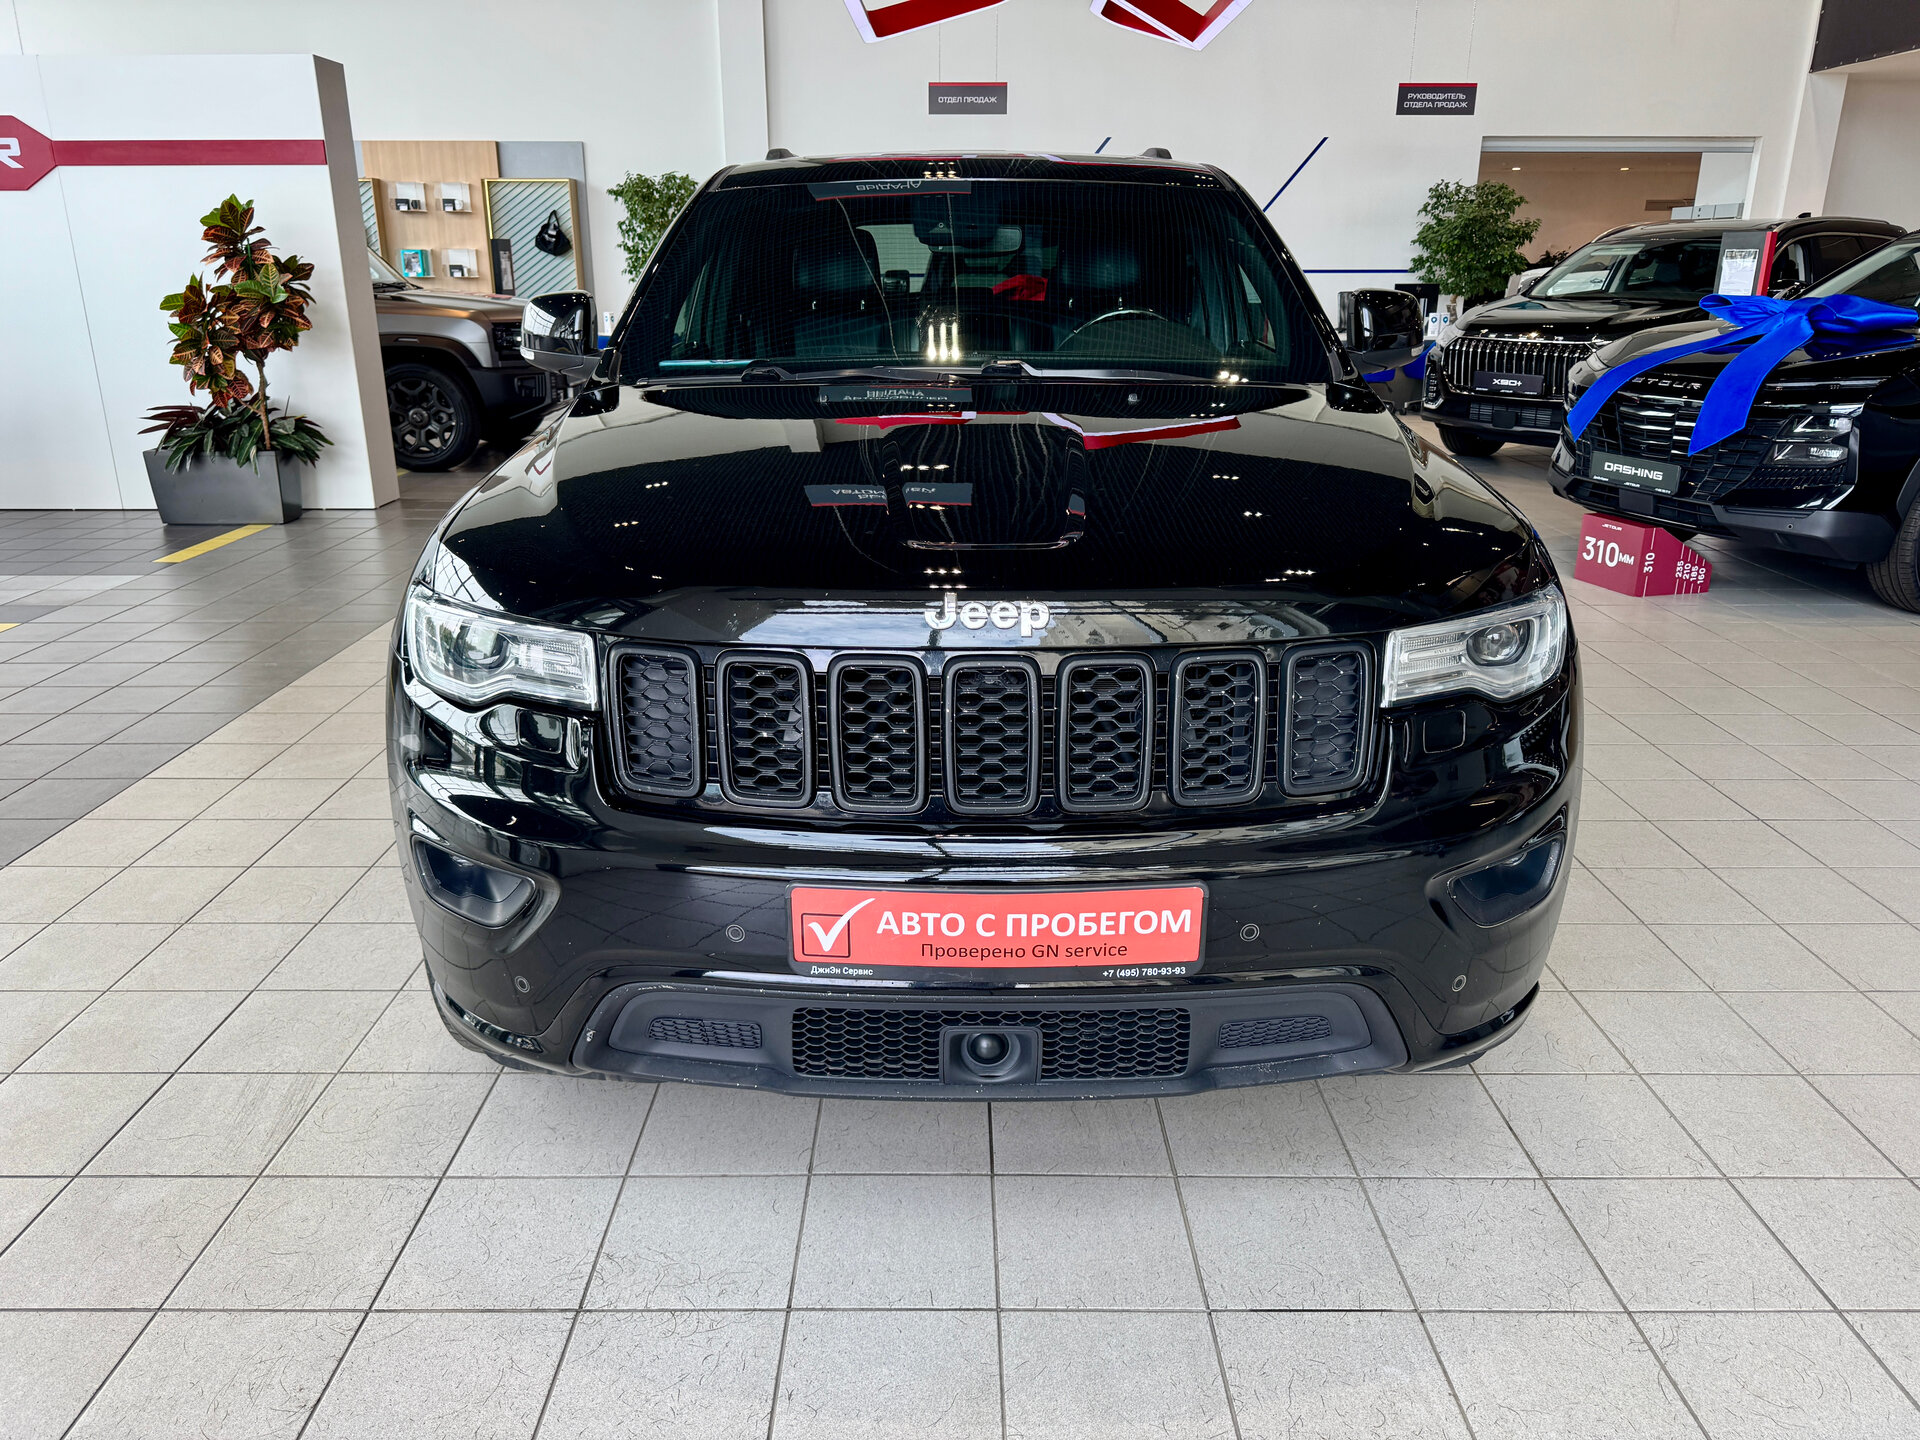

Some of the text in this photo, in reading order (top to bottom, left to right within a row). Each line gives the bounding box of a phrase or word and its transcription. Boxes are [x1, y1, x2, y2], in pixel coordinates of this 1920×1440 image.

[1604, 461, 1664, 481] DASHING
[1643, 552, 1656, 574] 310
[1675, 560, 1684, 578] 235
[1682, 563, 1692, 580] 210
[1690, 565, 1699, 582] 185
[924, 592, 1050, 638] Jeep
[876, 909, 1192, 937] АВТО С ПРОБЕГОМ
[921, 943, 1128, 961] Проверено GN service
[810, 965, 874, 976] ДжиЭн Сервис
[1102, 966, 1186, 979] +7 (495) 780-93-93
